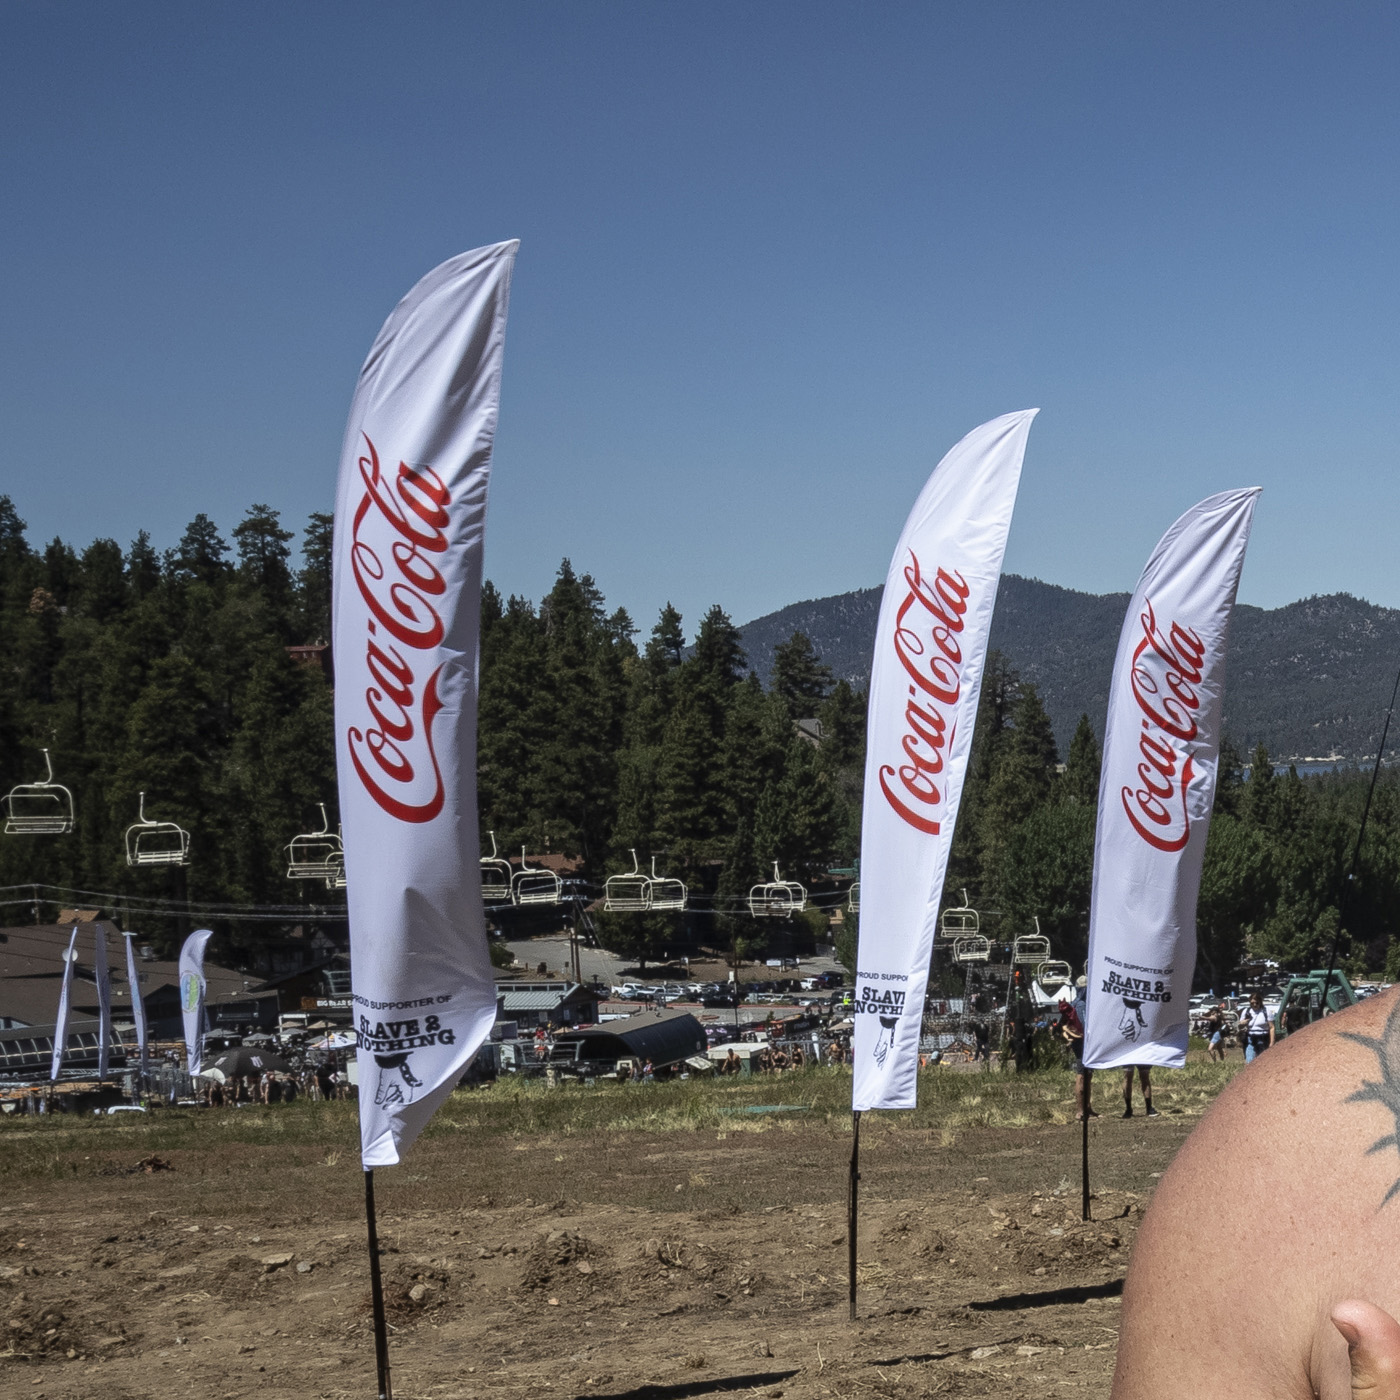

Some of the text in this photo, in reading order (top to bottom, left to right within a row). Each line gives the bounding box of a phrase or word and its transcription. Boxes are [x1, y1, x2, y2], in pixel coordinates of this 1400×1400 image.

[348, 431, 451, 824] Coca-Cola
[880, 549, 970, 835] Coca-Cola
[1121, 598, 1206, 852] Coca-Cola
[1123, 963, 1162, 974] SUPPORTER
[1101, 979, 1172, 1003] NOTHING
[1109, 971, 1164, 993] SLAVE 2
[371, 998, 434, 1010] SUPPORTER
[437, 995, 452, 1004] OF
[360, 1014, 441, 1039] SLAVE 2
[355, 1029, 456, 1052] NOTHING
